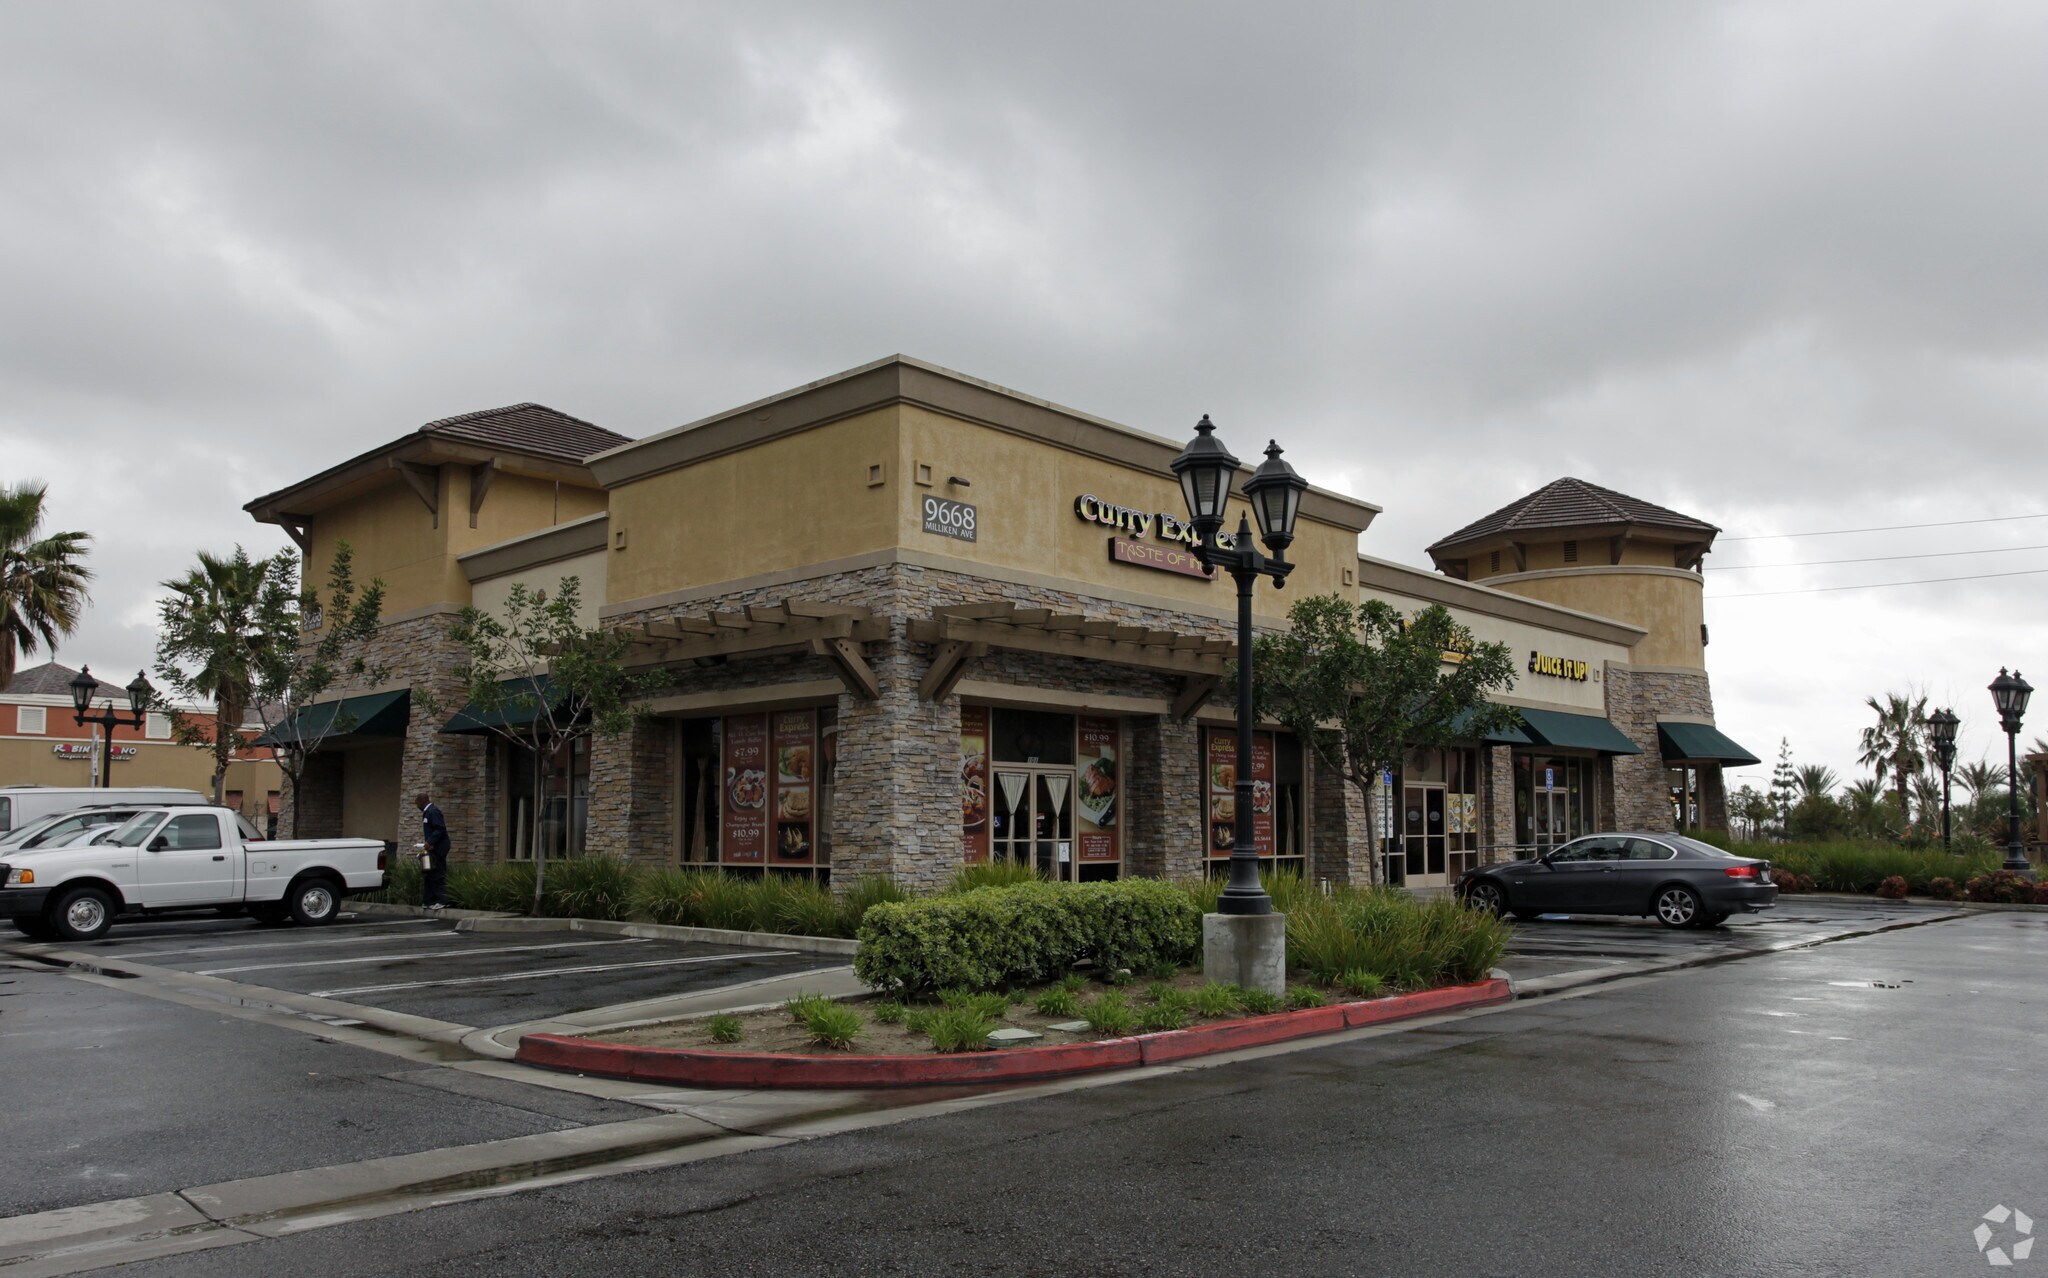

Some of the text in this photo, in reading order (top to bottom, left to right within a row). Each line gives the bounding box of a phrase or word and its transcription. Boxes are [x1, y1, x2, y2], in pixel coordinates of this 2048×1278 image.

[925, 498, 975, 530] 9668
[1080, 494, 1155, 539] Curry
[925, 521, 958, 536] MILLIKEN
[1117, 541, 1164, 562] TASTE
[1167, 552, 1186, 565] OF
[1534, 651, 1589, 681] JUICE IT UP!
[780, 722, 810, 733] Express
[1084, 733, 1110, 742] $10.99
[1214, 737, 1231, 746] Curry
[734, 747, 759, 758] $7.99
[1211, 743, 1235, 752] Express
[1251, 762, 1265, 770] 7.99
[732, 829, 760, 838] $10.99
